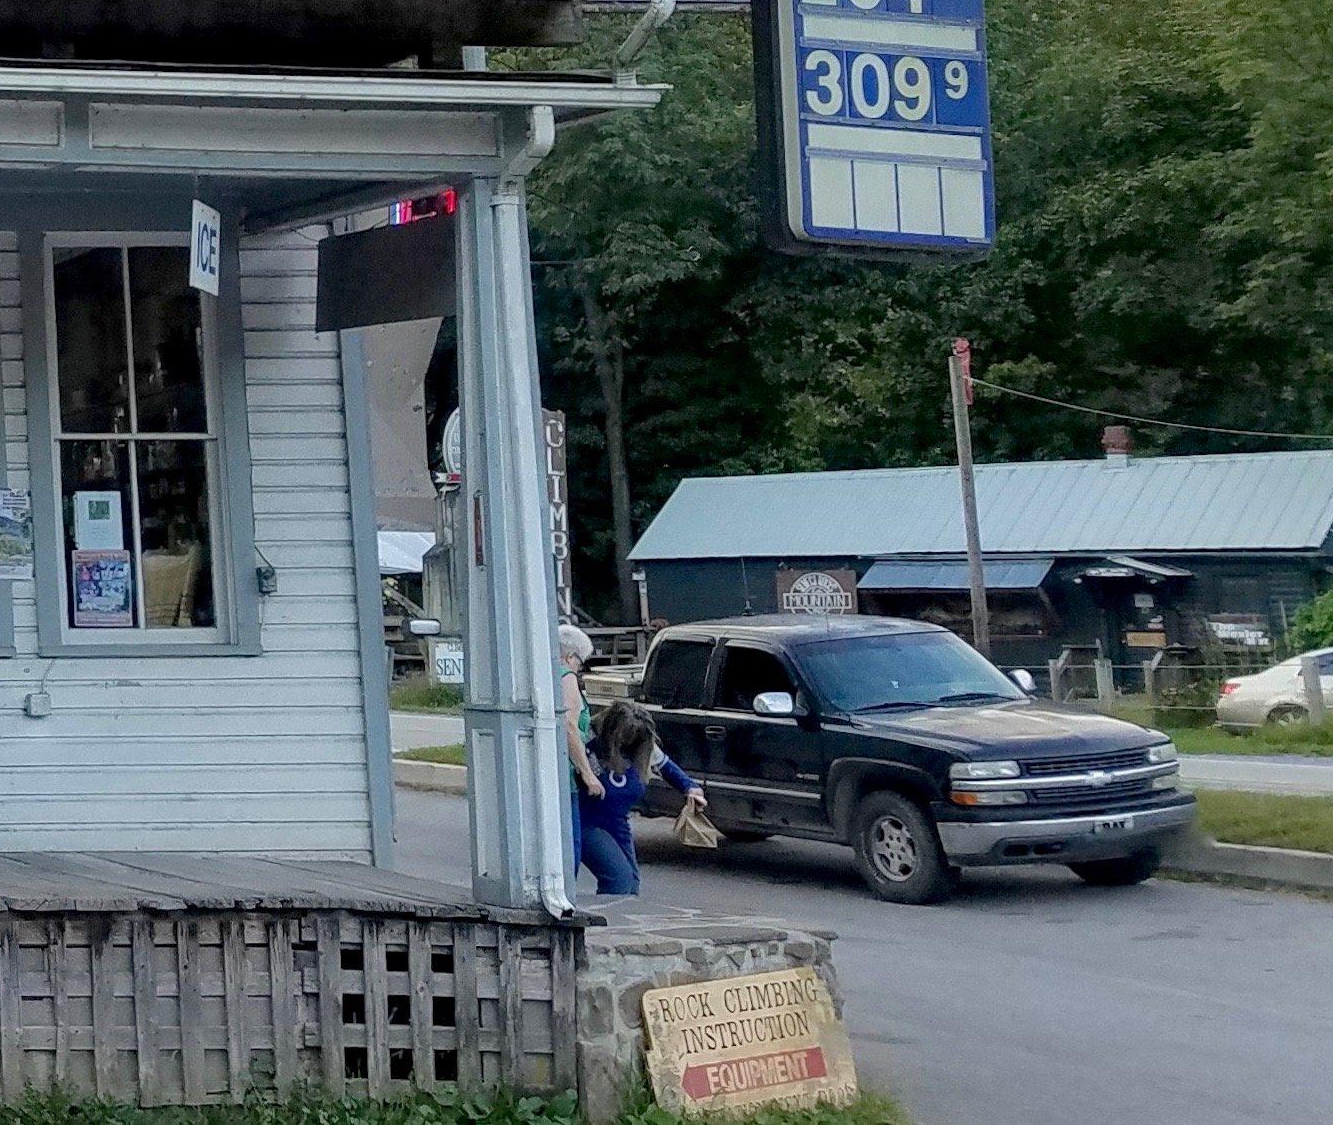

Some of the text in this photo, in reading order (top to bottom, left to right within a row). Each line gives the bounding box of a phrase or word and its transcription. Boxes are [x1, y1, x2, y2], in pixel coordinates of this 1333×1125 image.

[196, 220, 217, 275] ICE
[546, 419, 573, 625] CLIMBIN
[658, 977, 818, 1022] ROCK CLIMBING
[680, 1010, 811, 1054] INSTRUCTION
[706, 1053, 809, 1093] EQUIPMENT
